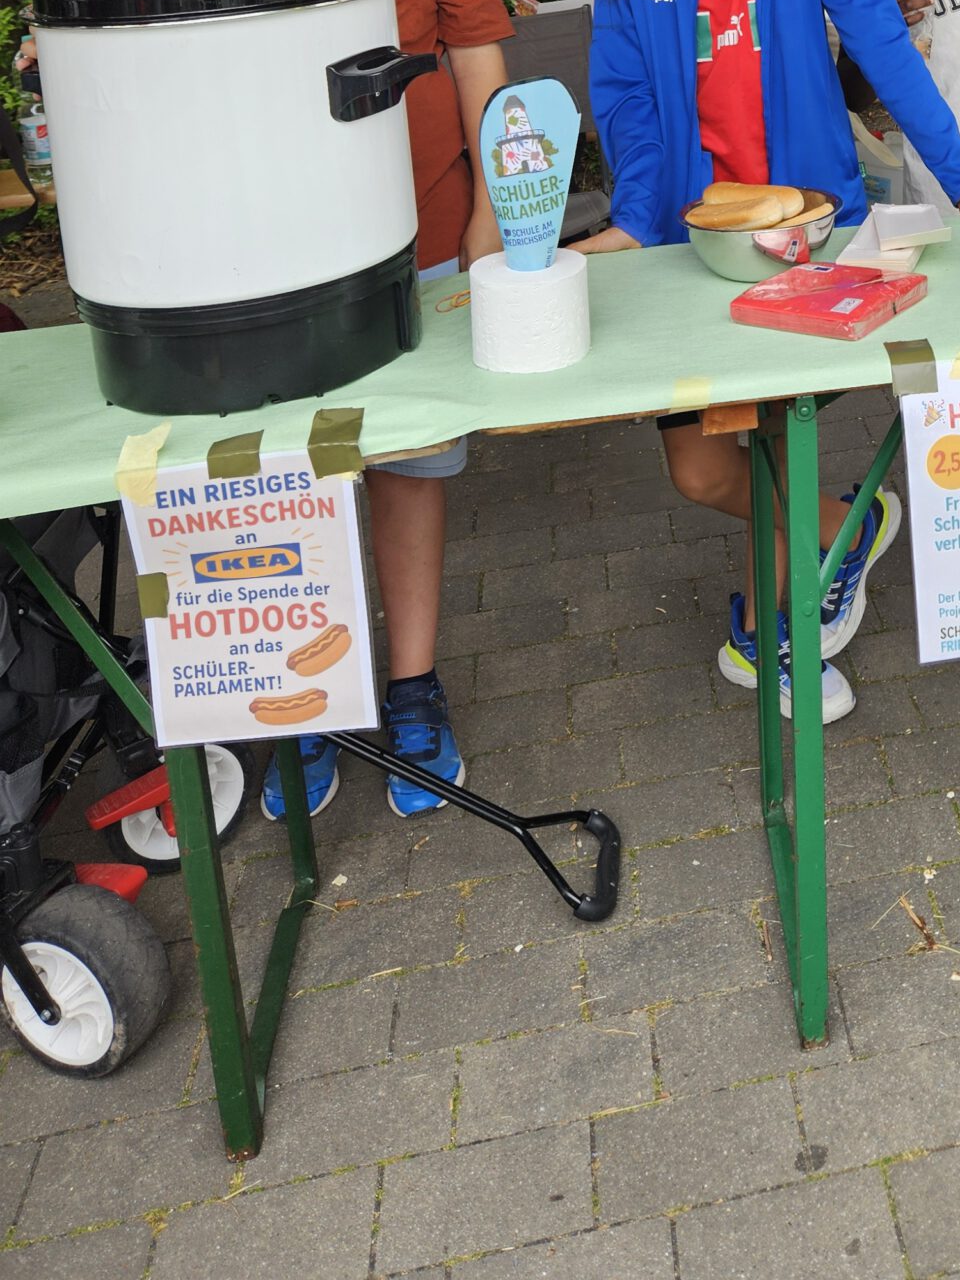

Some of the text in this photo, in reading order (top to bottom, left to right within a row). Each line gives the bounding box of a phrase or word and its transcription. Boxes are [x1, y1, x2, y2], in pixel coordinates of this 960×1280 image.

[492, 175, 564, 203] SCHÜLER-
[512, 220, 553, 237] SCHULE AM
[156, 471, 312, 509] EIN RIESIGES
[147, 493, 336, 538] DANKESCHÖN
[234, 532, 258, 545] an
[205, 552, 291, 573] IKEA
[175, 581, 330, 606] für die Spende der
[937, 592, 956, 604] Der
[168, 601, 329, 640] HOTDOGS
[229, 638, 283, 656] an das
[172, 660, 255, 681] SCHÜLER-
[174, 675, 283, 698] PARLAMENT!
